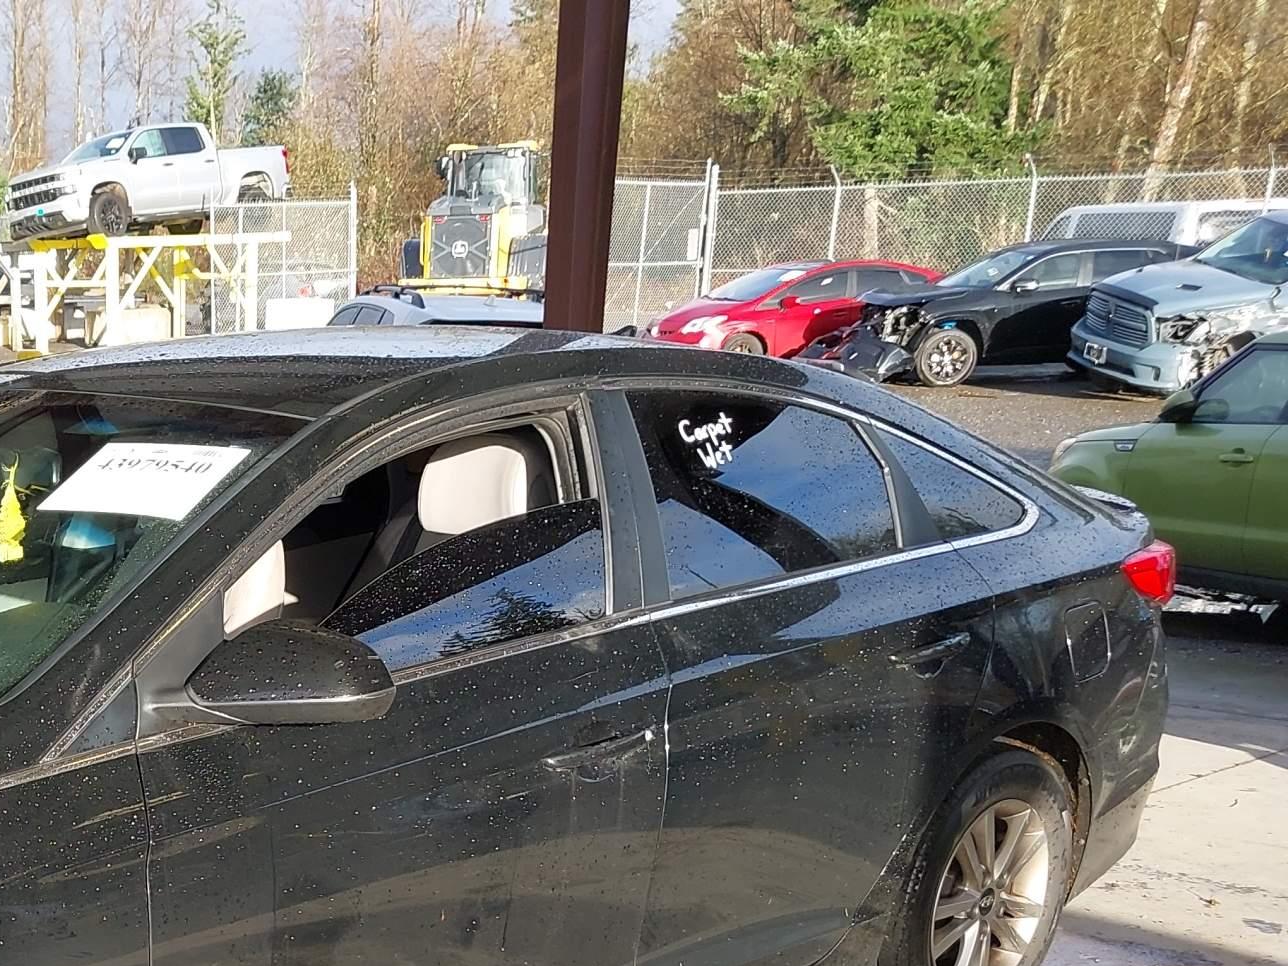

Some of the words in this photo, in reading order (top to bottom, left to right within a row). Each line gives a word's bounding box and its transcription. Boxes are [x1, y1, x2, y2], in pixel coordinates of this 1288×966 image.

[678, 411, 733, 446] Carpet
[97, 458, 213, 473] 43979540
[696, 440, 733, 468] Wet
